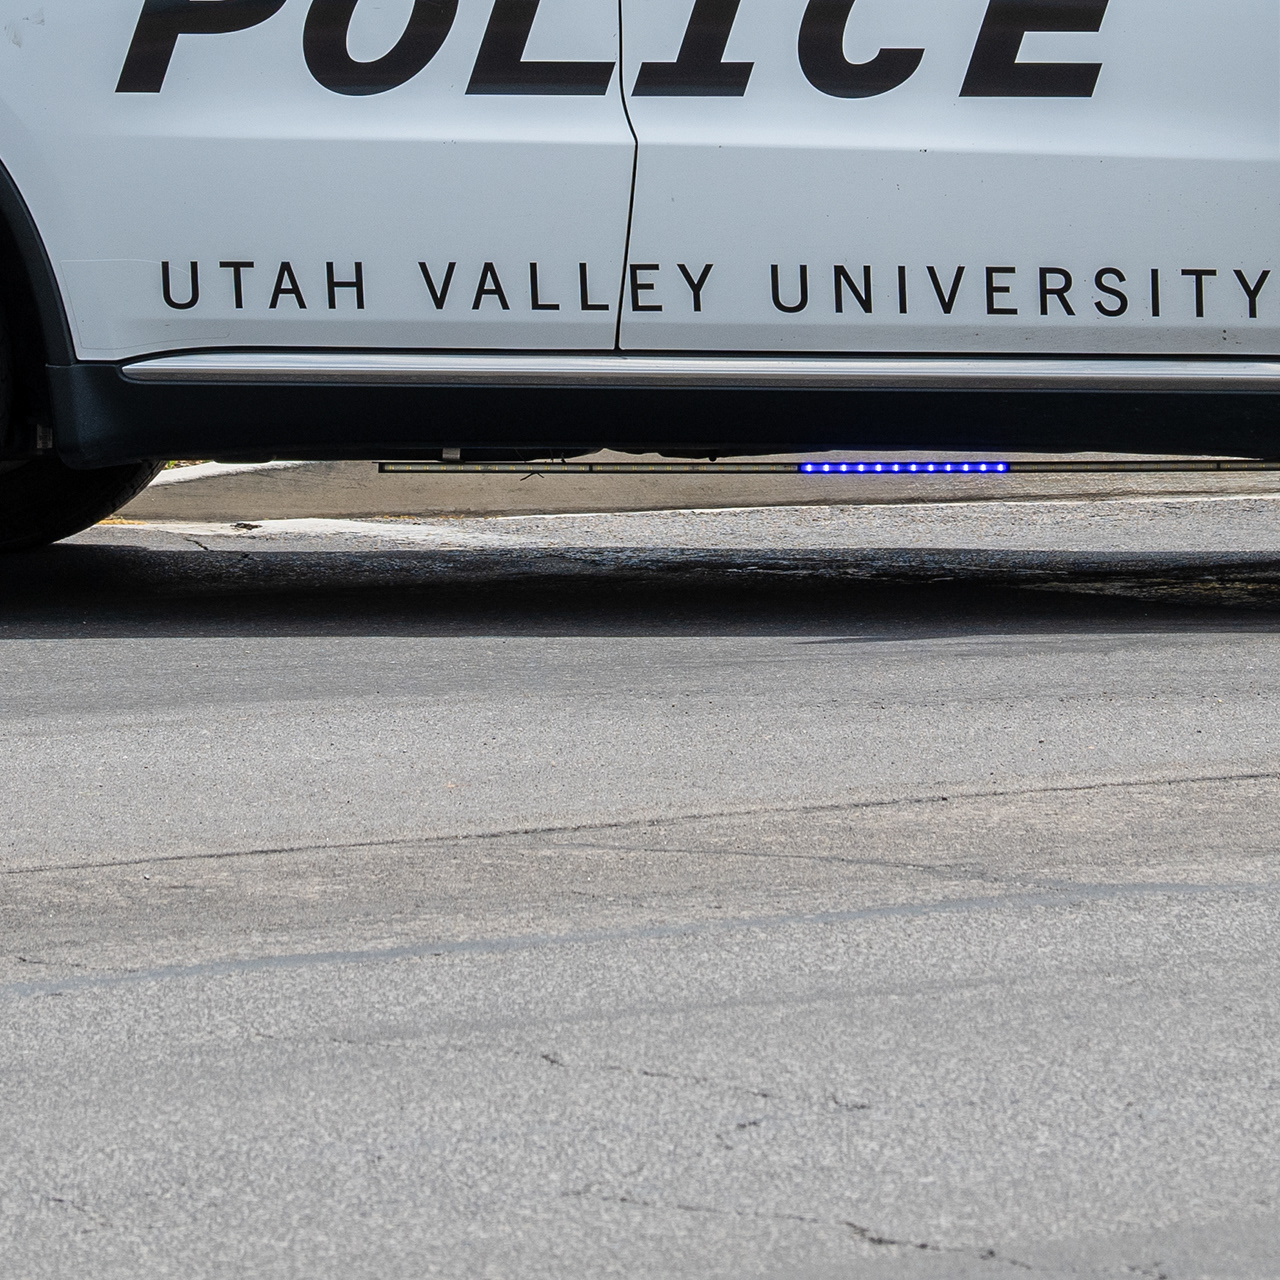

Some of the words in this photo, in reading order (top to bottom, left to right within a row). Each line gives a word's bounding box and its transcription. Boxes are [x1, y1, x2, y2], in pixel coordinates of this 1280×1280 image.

[160, 260, 366, 310] UTAH
[417, 261, 714, 312] VALLEY
[769, 263, 1272, 319] UNIVERSITY
